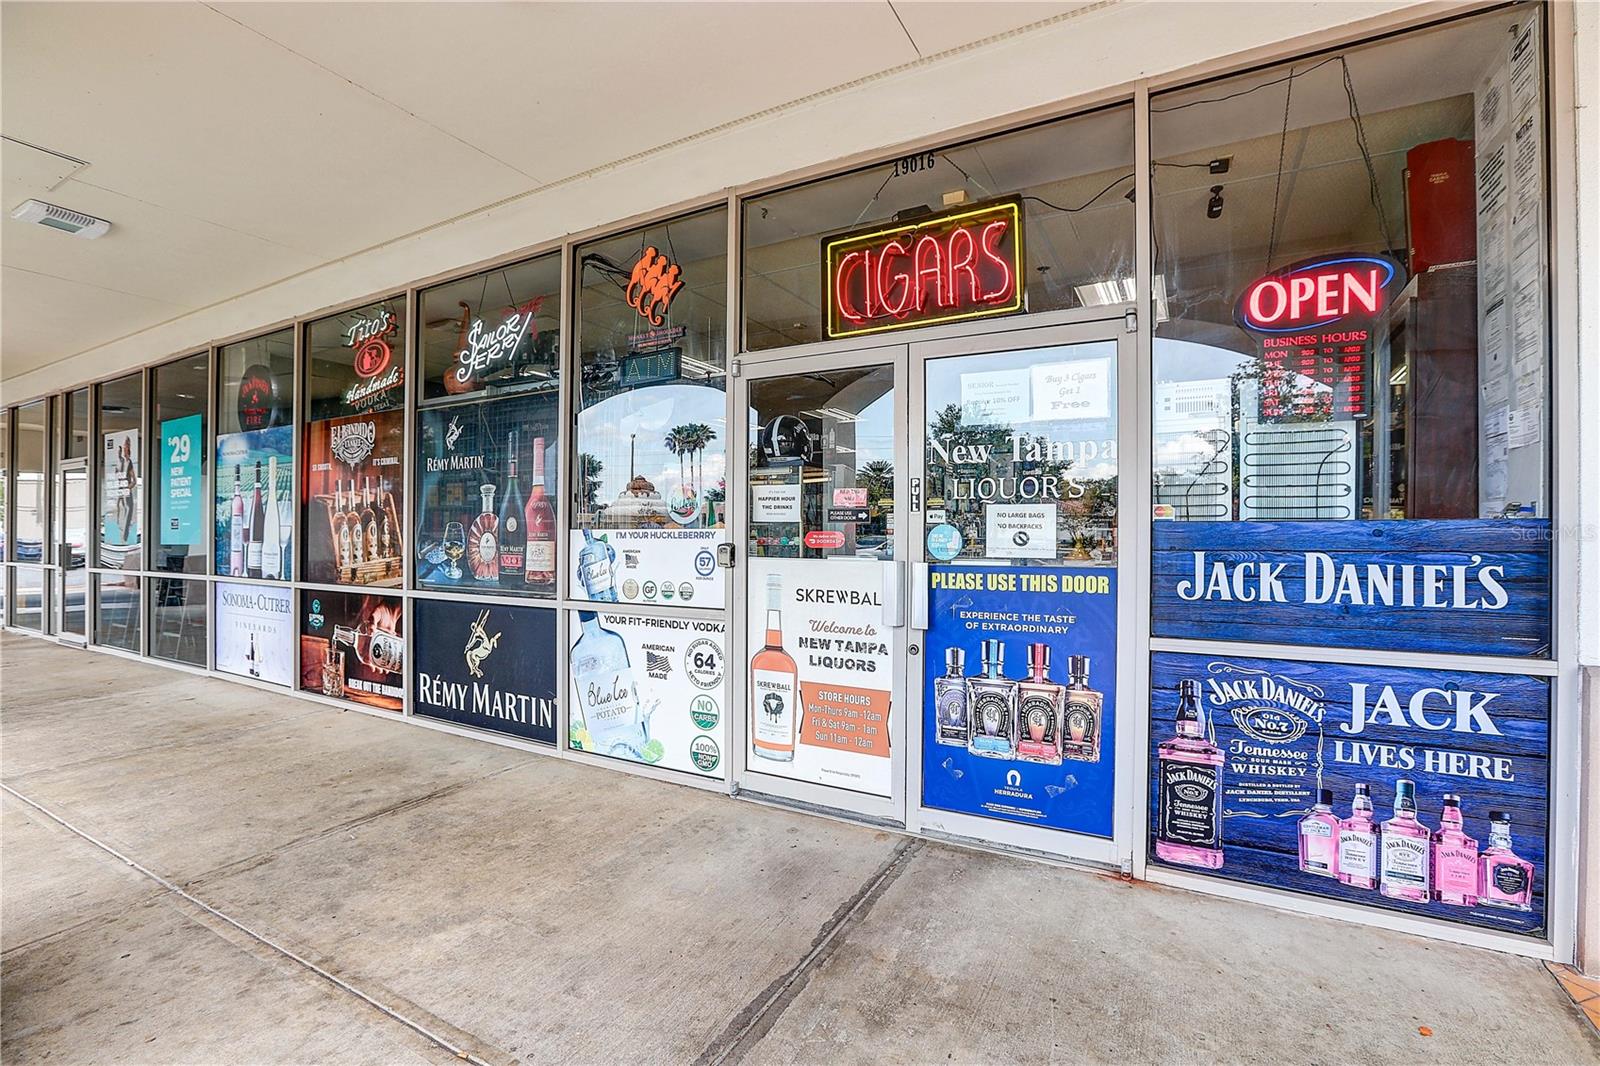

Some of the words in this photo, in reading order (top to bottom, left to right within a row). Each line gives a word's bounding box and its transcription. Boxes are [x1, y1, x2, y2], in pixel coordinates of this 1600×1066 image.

[893, 152, 935, 177] 19016
[836, 220, 1009, 320] CIGARS
[1249, 269, 1378, 323] OPEN
[347, 311, 390, 347] Tito's
[459, 313, 520, 364] SAILOR
[1263, 335, 1318, 348] BUSINESS
[1321, 330, 1368, 343] HOURS
[1264, 350, 1288, 359] MON
[626, 351, 674, 382] ATM
[346, 366, 399, 404] Handmade
[1044, 374, 1064, 386] Buy
[1071, 372, 1097, 384] Cigars
[1058, 386, 1074, 398] Get
[1050, 400, 1091, 410] Free
[167, 434, 191, 464] $29
[928, 435, 994, 465] New
[1005, 434, 1118, 469] Tampa
[170, 465, 185, 476] NEW
[426, 456, 450, 472] RÉMY
[450, 454, 485, 470] MARTIN
[910, 478, 920, 512] PULL
[615, 530, 627, 540] I'M
[627, 530, 649, 540] YOUR
[699, 556, 712, 567] 57
[931, 572, 984, 590] PLEASE
[986, 574, 1017, 592] USE
[1020, 574, 1058, 593] THIS
[1061, 575, 1110, 594] DOOR
[1176, 550, 1289, 603] JACK
[1303, 552, 1510, 610] DANIEL'S
[644, 585, 655, 594] GF
[603, 614, 627, 626] YOUR
[628, 617, 690, 631] FIT-FRIENDLY
[959, 611, 1019, 622] EXPERIENCE
[1021, 613, 1041, 622] THE
[1043, 614, 1077, 624] TASTE
[235, 621, 277, 634] VINEYARDS
[808, 619, 863, 636] Welcome
[863, 623, 878, 637] to
[965, 621, 979, 631] OF
[981, 622, 1069, 634] EXTRAORDINARY
[641, 643, 675, 653] AMERICAN
[798, 636, 832, 650] NEW
[834, 639, 889, 656] TAMPA
[693, 651, 717, 671] 64
[808, 654, 877, 673] LIQUORS
[648, 672, 668, 680] MADE
[693, 668, 716, 676] CALORIES
[587, 681, 612, 707] Blue
[613, 675, 628, 701] Ice
[756, 680, 791, 691] SKREWBALL
[418, 672, 468, 715] RÉMY
[472, 682, 553, 729] MARTIN
[697, 699, 713, 712] NO
[818, 690, 843, 703] STORE
[844, 693, 871, 706] HOURS
[1207, 678, 1260, 706] JACK
[1261, 676, 1327, 724] DANIEL'S
[808, 703, 843, 717] Mon-Thurs
[843, 708, 859, 718] 9am
[1339, 681, 1505, 737] JACK
[811, 716, 821, 727] Fri
[821, 719, 827, 728] &
[828, 719, 840, 729] Sat
[841, 721, 856, 731] 9am
[863, 724, 878, 736] 1am
[695, 742, 717, 754] 100%
[815, 730, 829, 741] Sun
[829, 733, 848, 745] 11am
[854, 736, 873, 749] 12am
[1229, 739, 1308, 760] Tennessee
[1231, 763, 1307, 777] WHISKEY
[1333, 740, 1416, 771] LIVES
[1423, 749, 1515, 783] HERE
[1166, 770, 1187, 785] JACK
[994, 788, 1034, 800] HERRADURA
[1173, 799, 1209, 811] Tennessee
[1174, 809, 1208, 820] WHISKEY
[1385, 841, 1401, 850] JACK
